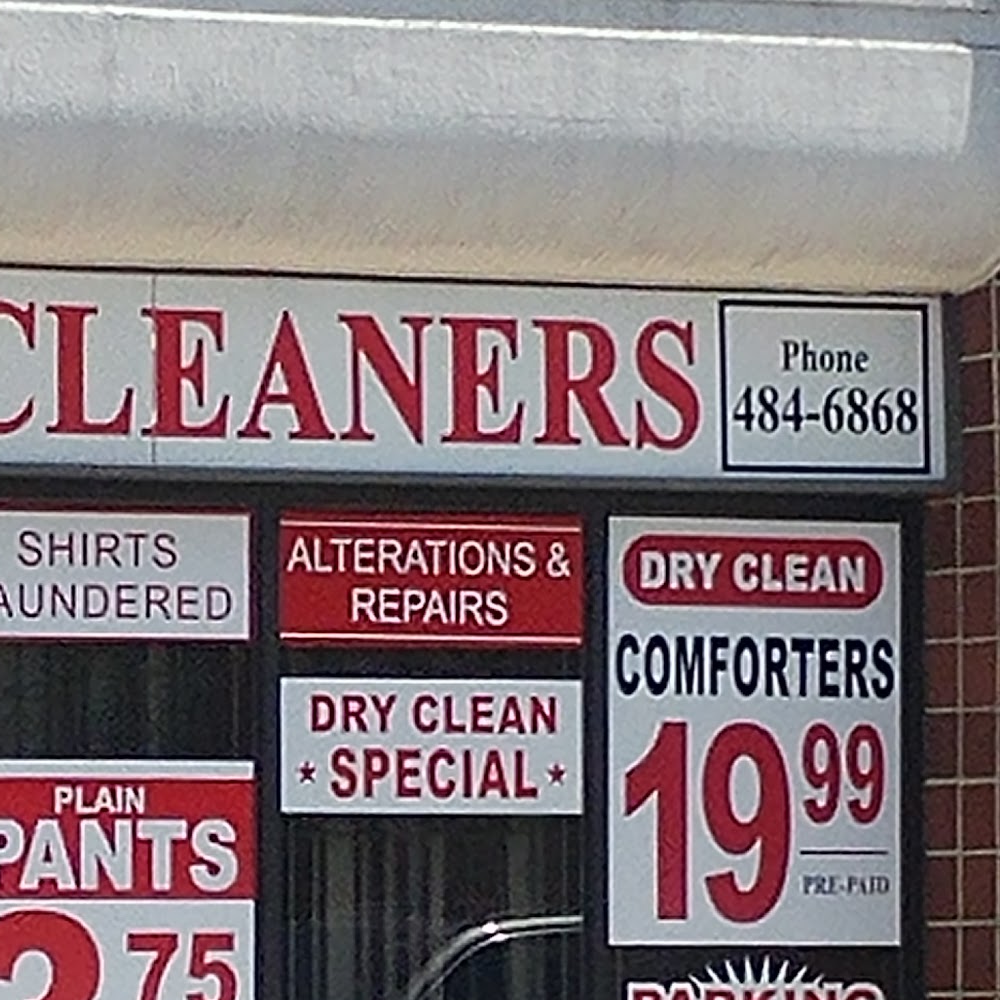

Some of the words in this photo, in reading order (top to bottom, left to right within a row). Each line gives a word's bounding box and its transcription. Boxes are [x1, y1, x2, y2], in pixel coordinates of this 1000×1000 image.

[782, 339, 869, 374] Phone
[733, 385, 920, 435] 484-6868
[17, 530, 177, 569] SHIRTS
[287, 537, 537, 579] ALTERATIONS
[547, 542, 572, 578] &
[637, 550, 723, 590] DRY
[732, 553, 867, 593] CLEAN
[351, 588, 509, 627] REPAIRS
[616, 633, 896, 699] COMFORTERS
[310, 694, 396, 734] DRY
[413, 695, 558, 736] CLEAN
[330, 747, 540, 799] SPECIAL
[53, 786, 146, 815] PLAIN
[624, 721, 793, 924] 19
[802, 722, 886, 825] 99
[802, 875, 890, 897] PRE-PAID
